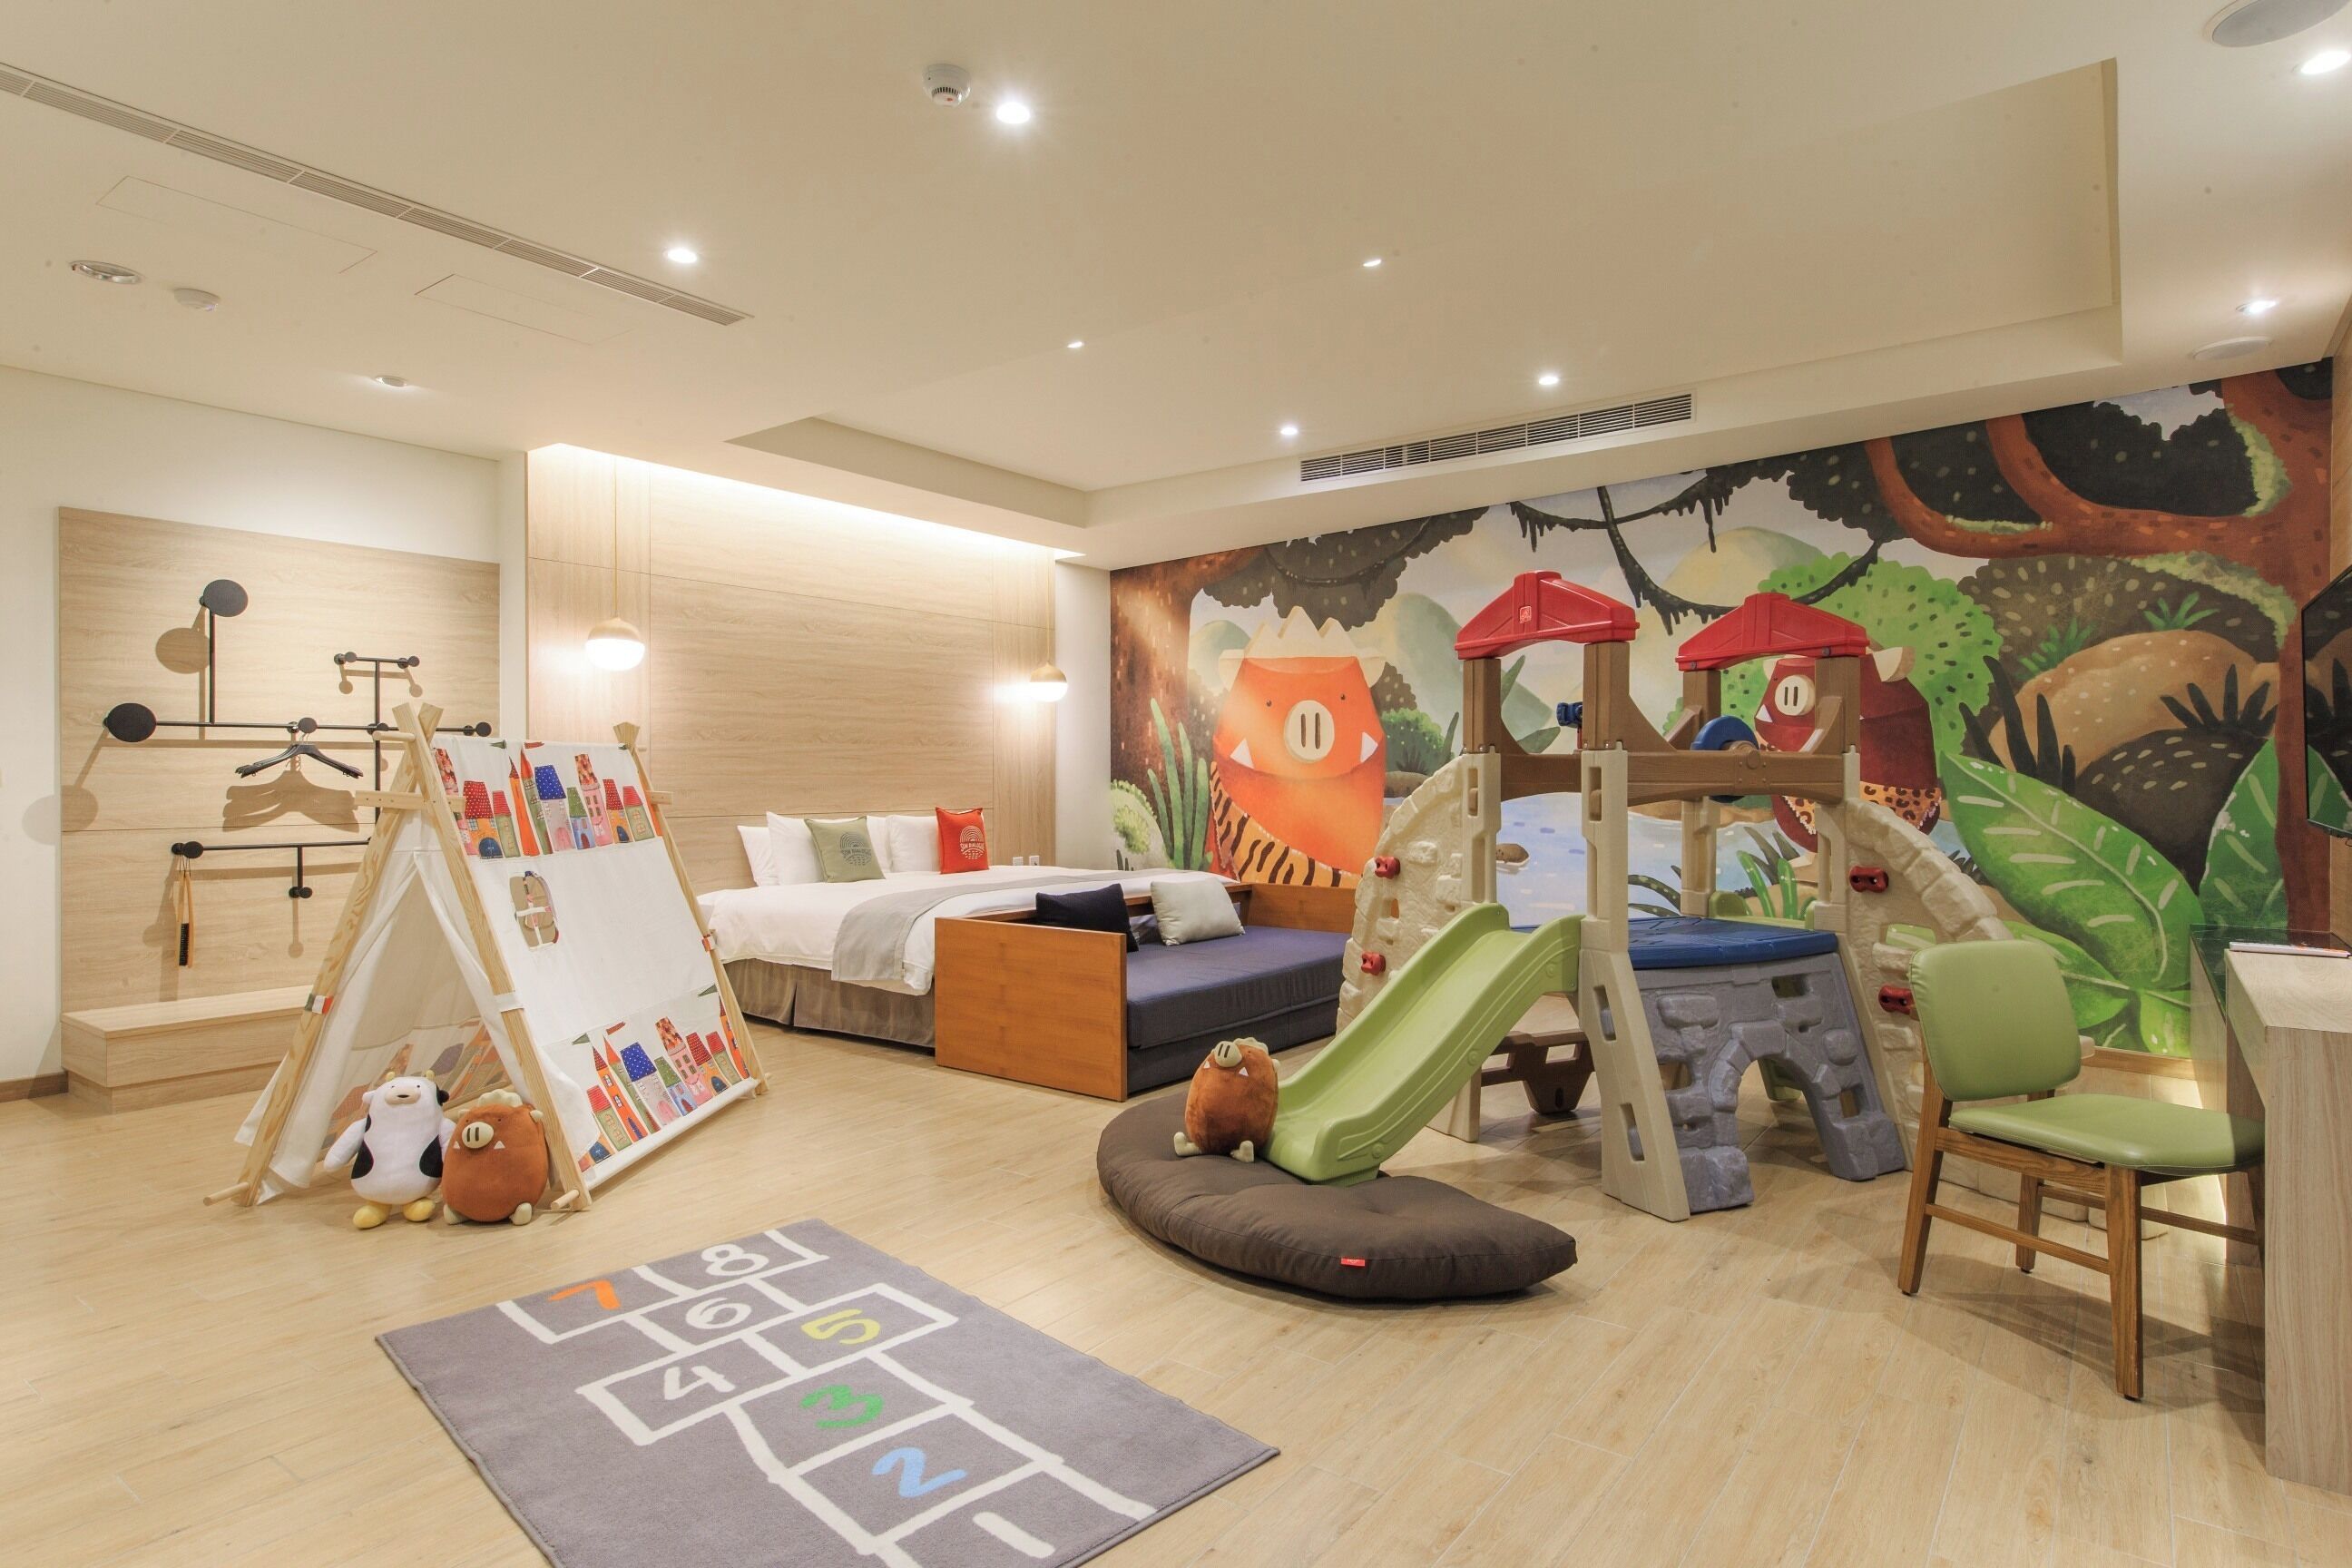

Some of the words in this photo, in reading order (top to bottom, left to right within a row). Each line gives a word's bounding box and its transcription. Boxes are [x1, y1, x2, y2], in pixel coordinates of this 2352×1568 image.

[701, 1243, 769, 1277] 8
[548, 1279, 621, 1310] 7
[685, 1298, 752, 1329] 6
[800, 1308, 881, 1345] 5
[663, 1365, 736, 1401] 4
[799, 1384, 885, 1429] 3
[870, 1446, 968, 1498] 2
[972, 1511, 1056, 1559] 1
